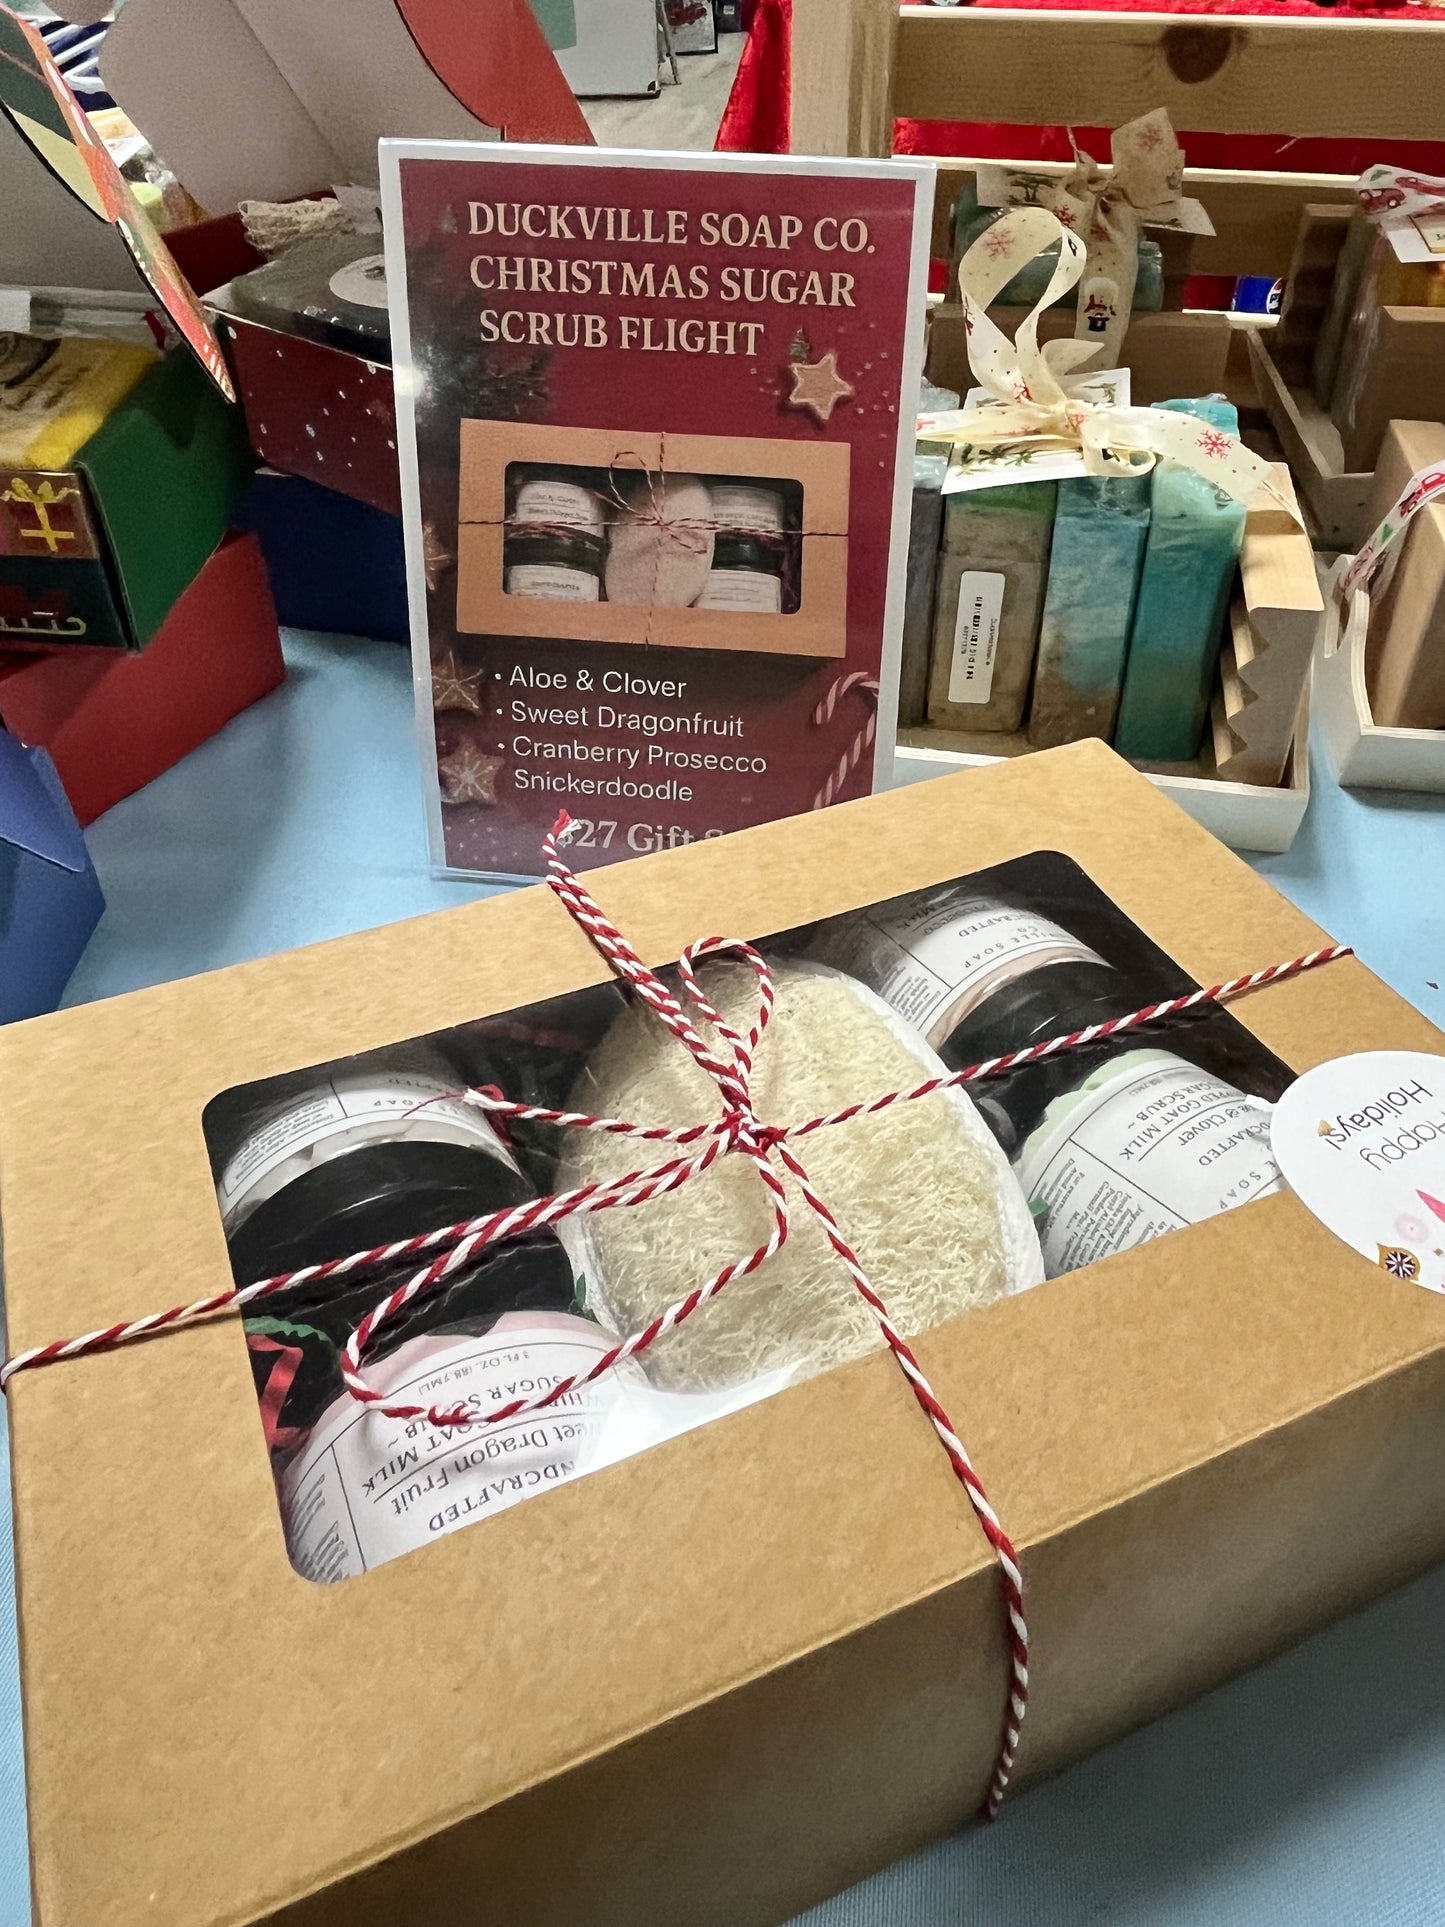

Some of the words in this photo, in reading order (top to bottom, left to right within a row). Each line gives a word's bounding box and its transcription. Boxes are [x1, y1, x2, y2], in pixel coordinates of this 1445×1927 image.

[468, 201, 688, 245] DUCKVILLE
[700, 212, 803, 250] SOAP
[813, 216, 875, 254] CO.
[470, 255, 709, 299] CHRISTMAS
[720, 267, 856, 307] SUGAR
[480, 309, 608, 348] SCRUB
[618, 316, 764, 356] FLIGHT
[510, 666, 567, 689] Aloe
[576, 669, 594, 691] &
[602, 671, 687, 698] Clover
[511, 701, 589, 726] Sweet
[598, 706, 744, 737] Dragonfruit
[513, 736, 640, 769] Cranberry
[648, 745, 767, 773] Prosecco
[514, 769, 693, 801] Snickerdoodle
[567, 819, 617, 849] 27
[963, 942, 1004, 969] SOAP
[1136, 1089, 1185, 1121] SCRUB
[1159, 1098, 1201, 1126] GOAT
[1324, 1079, 1433, 1151] Holidays!
[1119, 1123, 1161, 1161] MILK
[1177, 1113, 1226, 1146] Clover
[1198, 1120, 1271, 1166] DCRAFTED
[1218, 1171, 1262, 1210] SOAP
[455, 1428, 549, 1475] Dragon
[362, 1446, 419, 1497] MILK
[390, 1466, 450, 1516] Fruit
